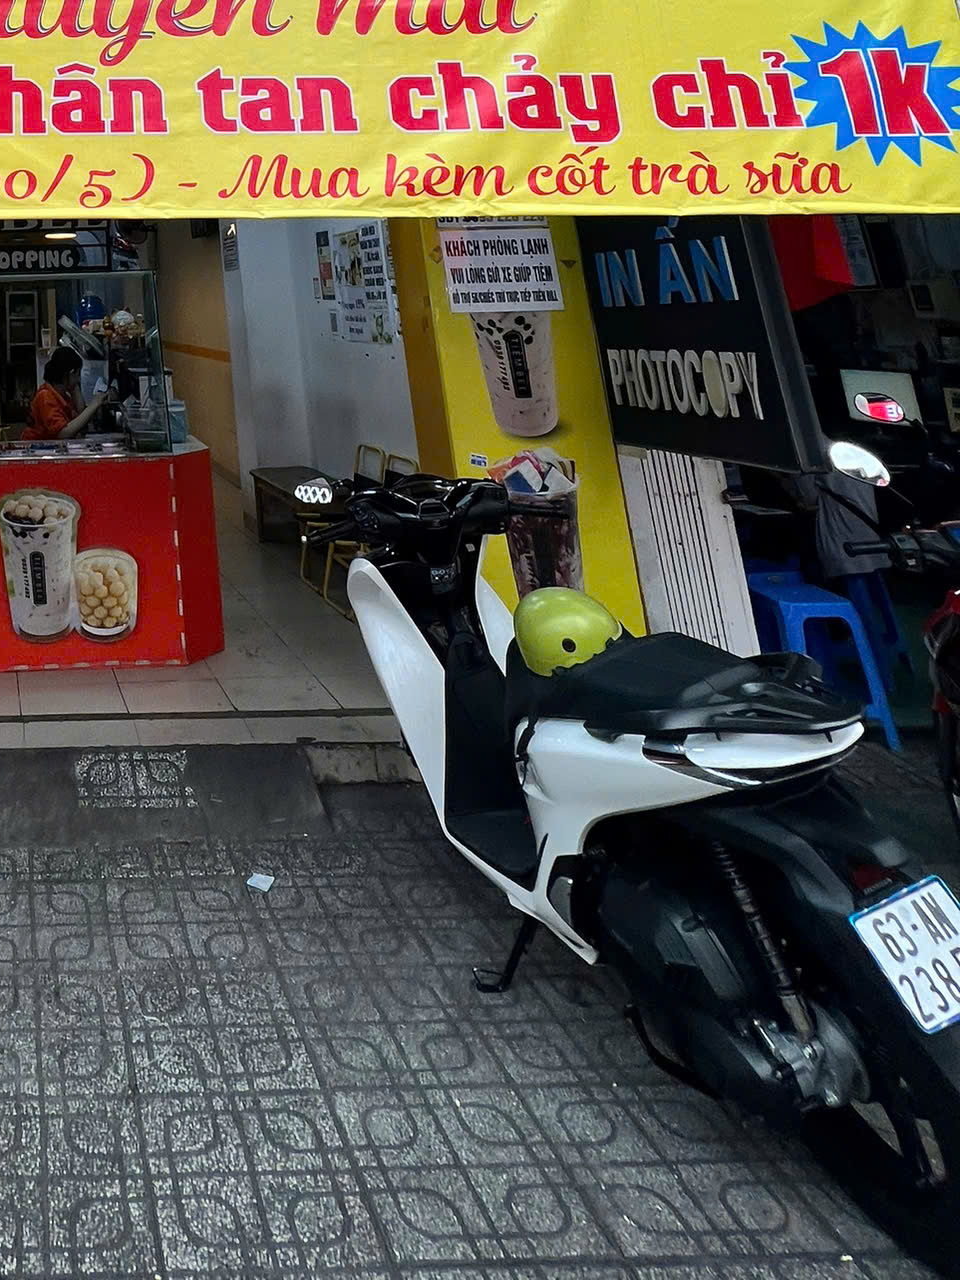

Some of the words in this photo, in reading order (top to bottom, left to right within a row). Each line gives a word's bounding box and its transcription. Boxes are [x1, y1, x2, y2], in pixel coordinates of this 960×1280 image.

[195, 62, 362, 135] tan
[387, 52, 617, 145] chảy
[653, 49, 808, 132] chỉ
[217, 154, 371, 202] Mua
[386, 144, 516, 200] kèm
[527, 142, 616, 197] cốt
[631, 148, 728, 197] trà
[743, 150, 853, 196] sữa
[444, 237, 481, 257] KHÁCH
[482, 235, 518, 257] PHÒNG
[520, 237, 550, 259] LẠNH
[450, 267, 465, 285] VUI
[466, 263, 486, 284] LÒNG
[502, 267, 512, 283] XE
[595, 249, 645, 308] IN
[655, 217, 740, 305] ẤN
[606, 348, 765, 421] PHOTOCOPY
[898, 946, 960, 1023] 238
